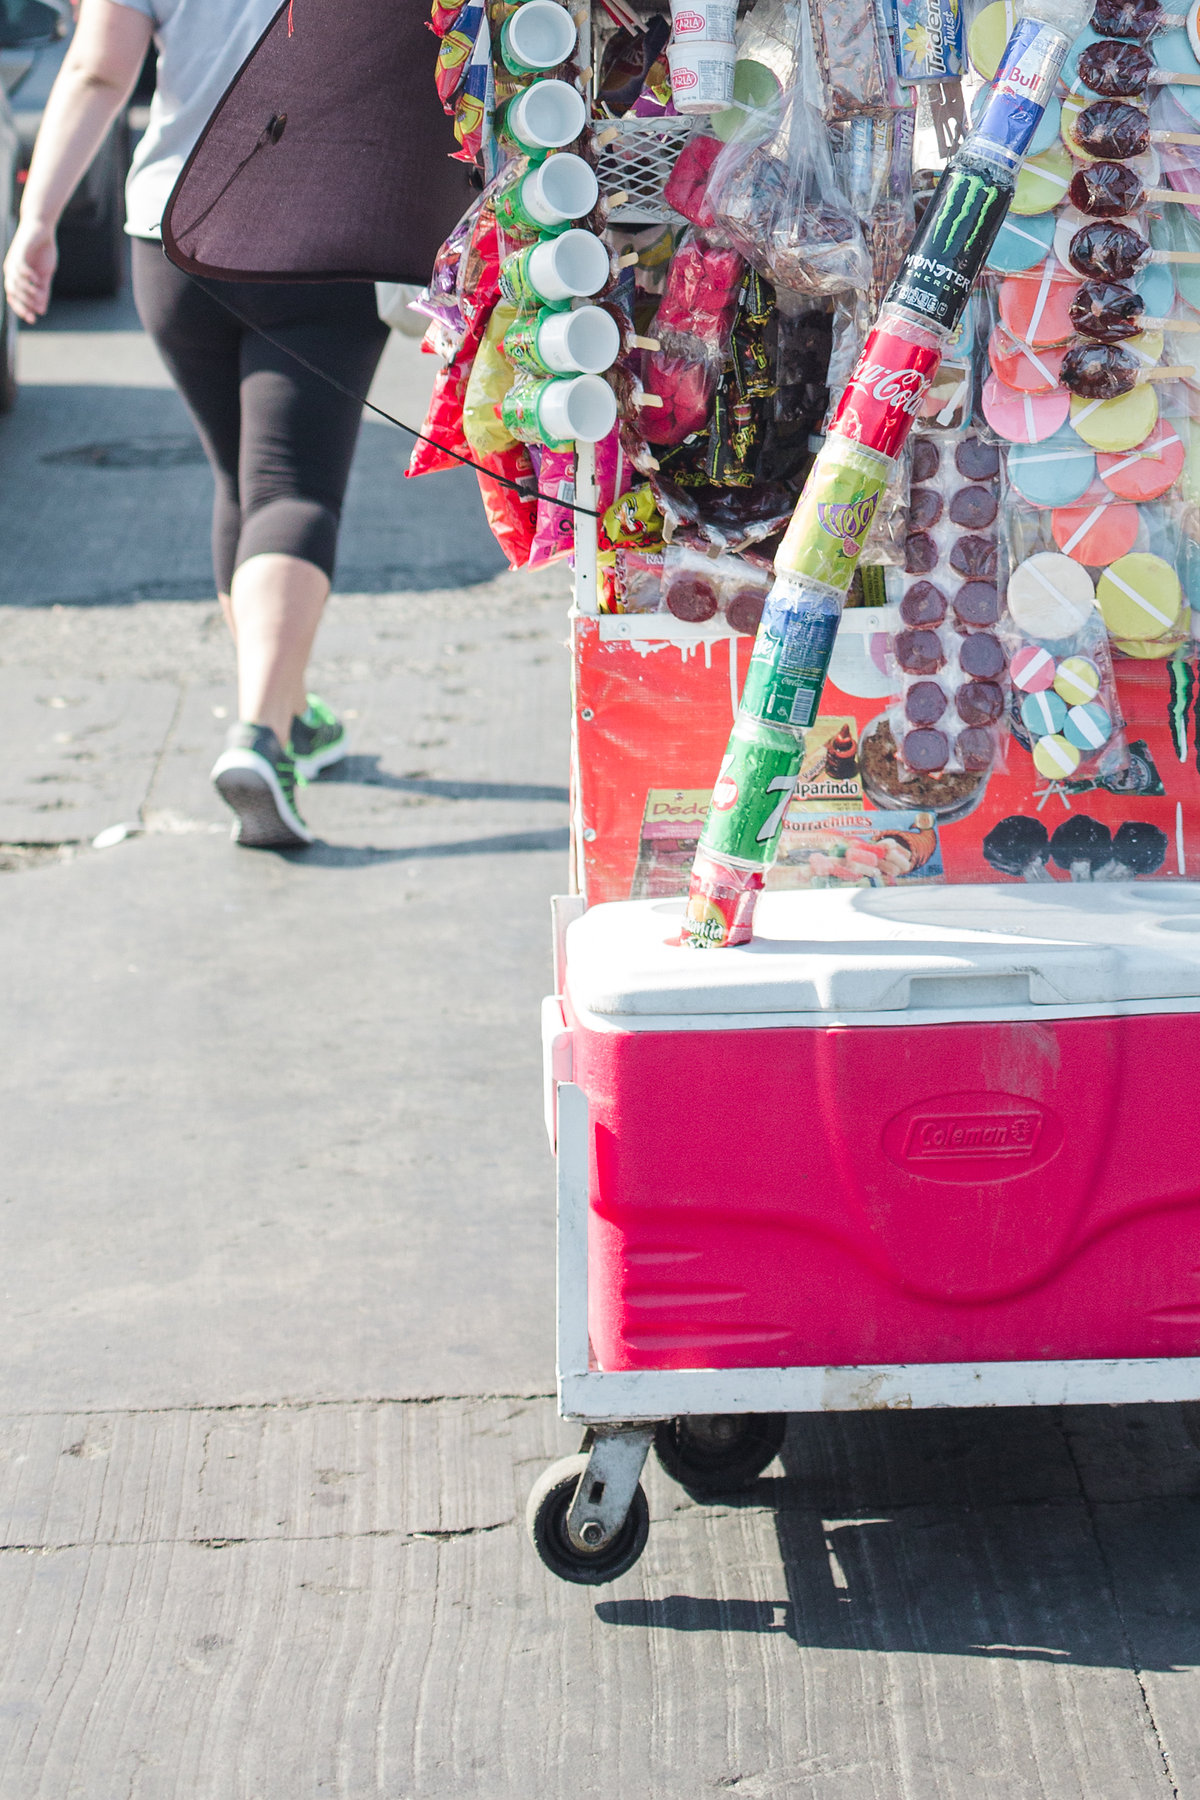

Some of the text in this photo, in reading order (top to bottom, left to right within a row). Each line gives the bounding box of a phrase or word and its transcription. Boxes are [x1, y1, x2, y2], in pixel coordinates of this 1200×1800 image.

[943, 10, 955, 46] Twist
[673, 76, 693, 88] ARLA
[1008, 66, 1042, 91] Bull
[904, 253, 970, 292] MONSTER
[906, 269, 958, 295] ENERGY
[793, 780, 858, 797] lparindo
[757, 774, 798, 844] 7
[920, 1121, 1008, 1147] Coleman
